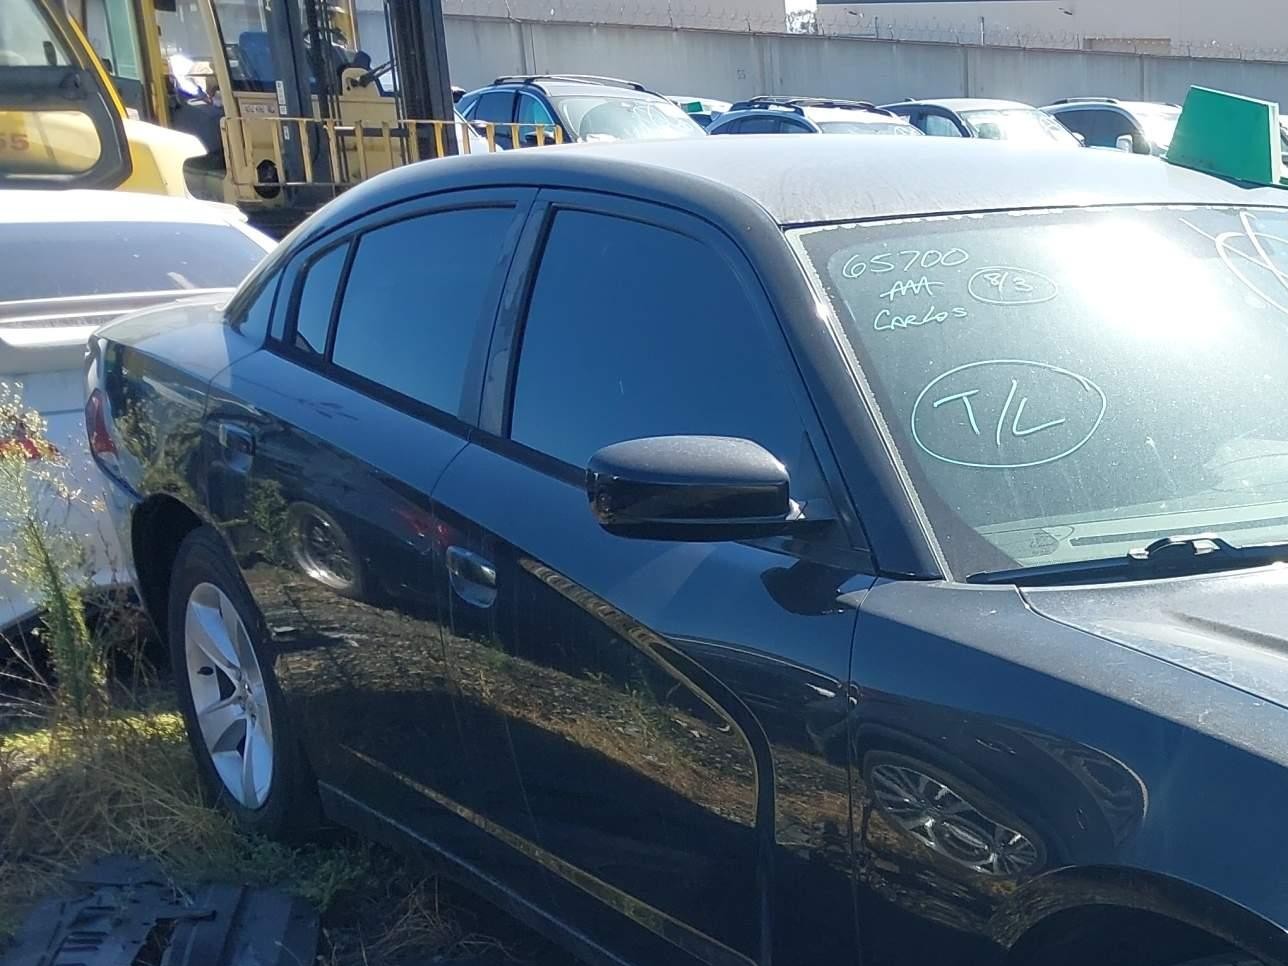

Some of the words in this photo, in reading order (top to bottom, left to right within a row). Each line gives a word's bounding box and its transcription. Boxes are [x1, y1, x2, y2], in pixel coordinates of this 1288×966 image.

[842, 247, 969, 278] 65700
[879, 275, 944, 301] AAA
[932, 379, 1066, 446] T/L
